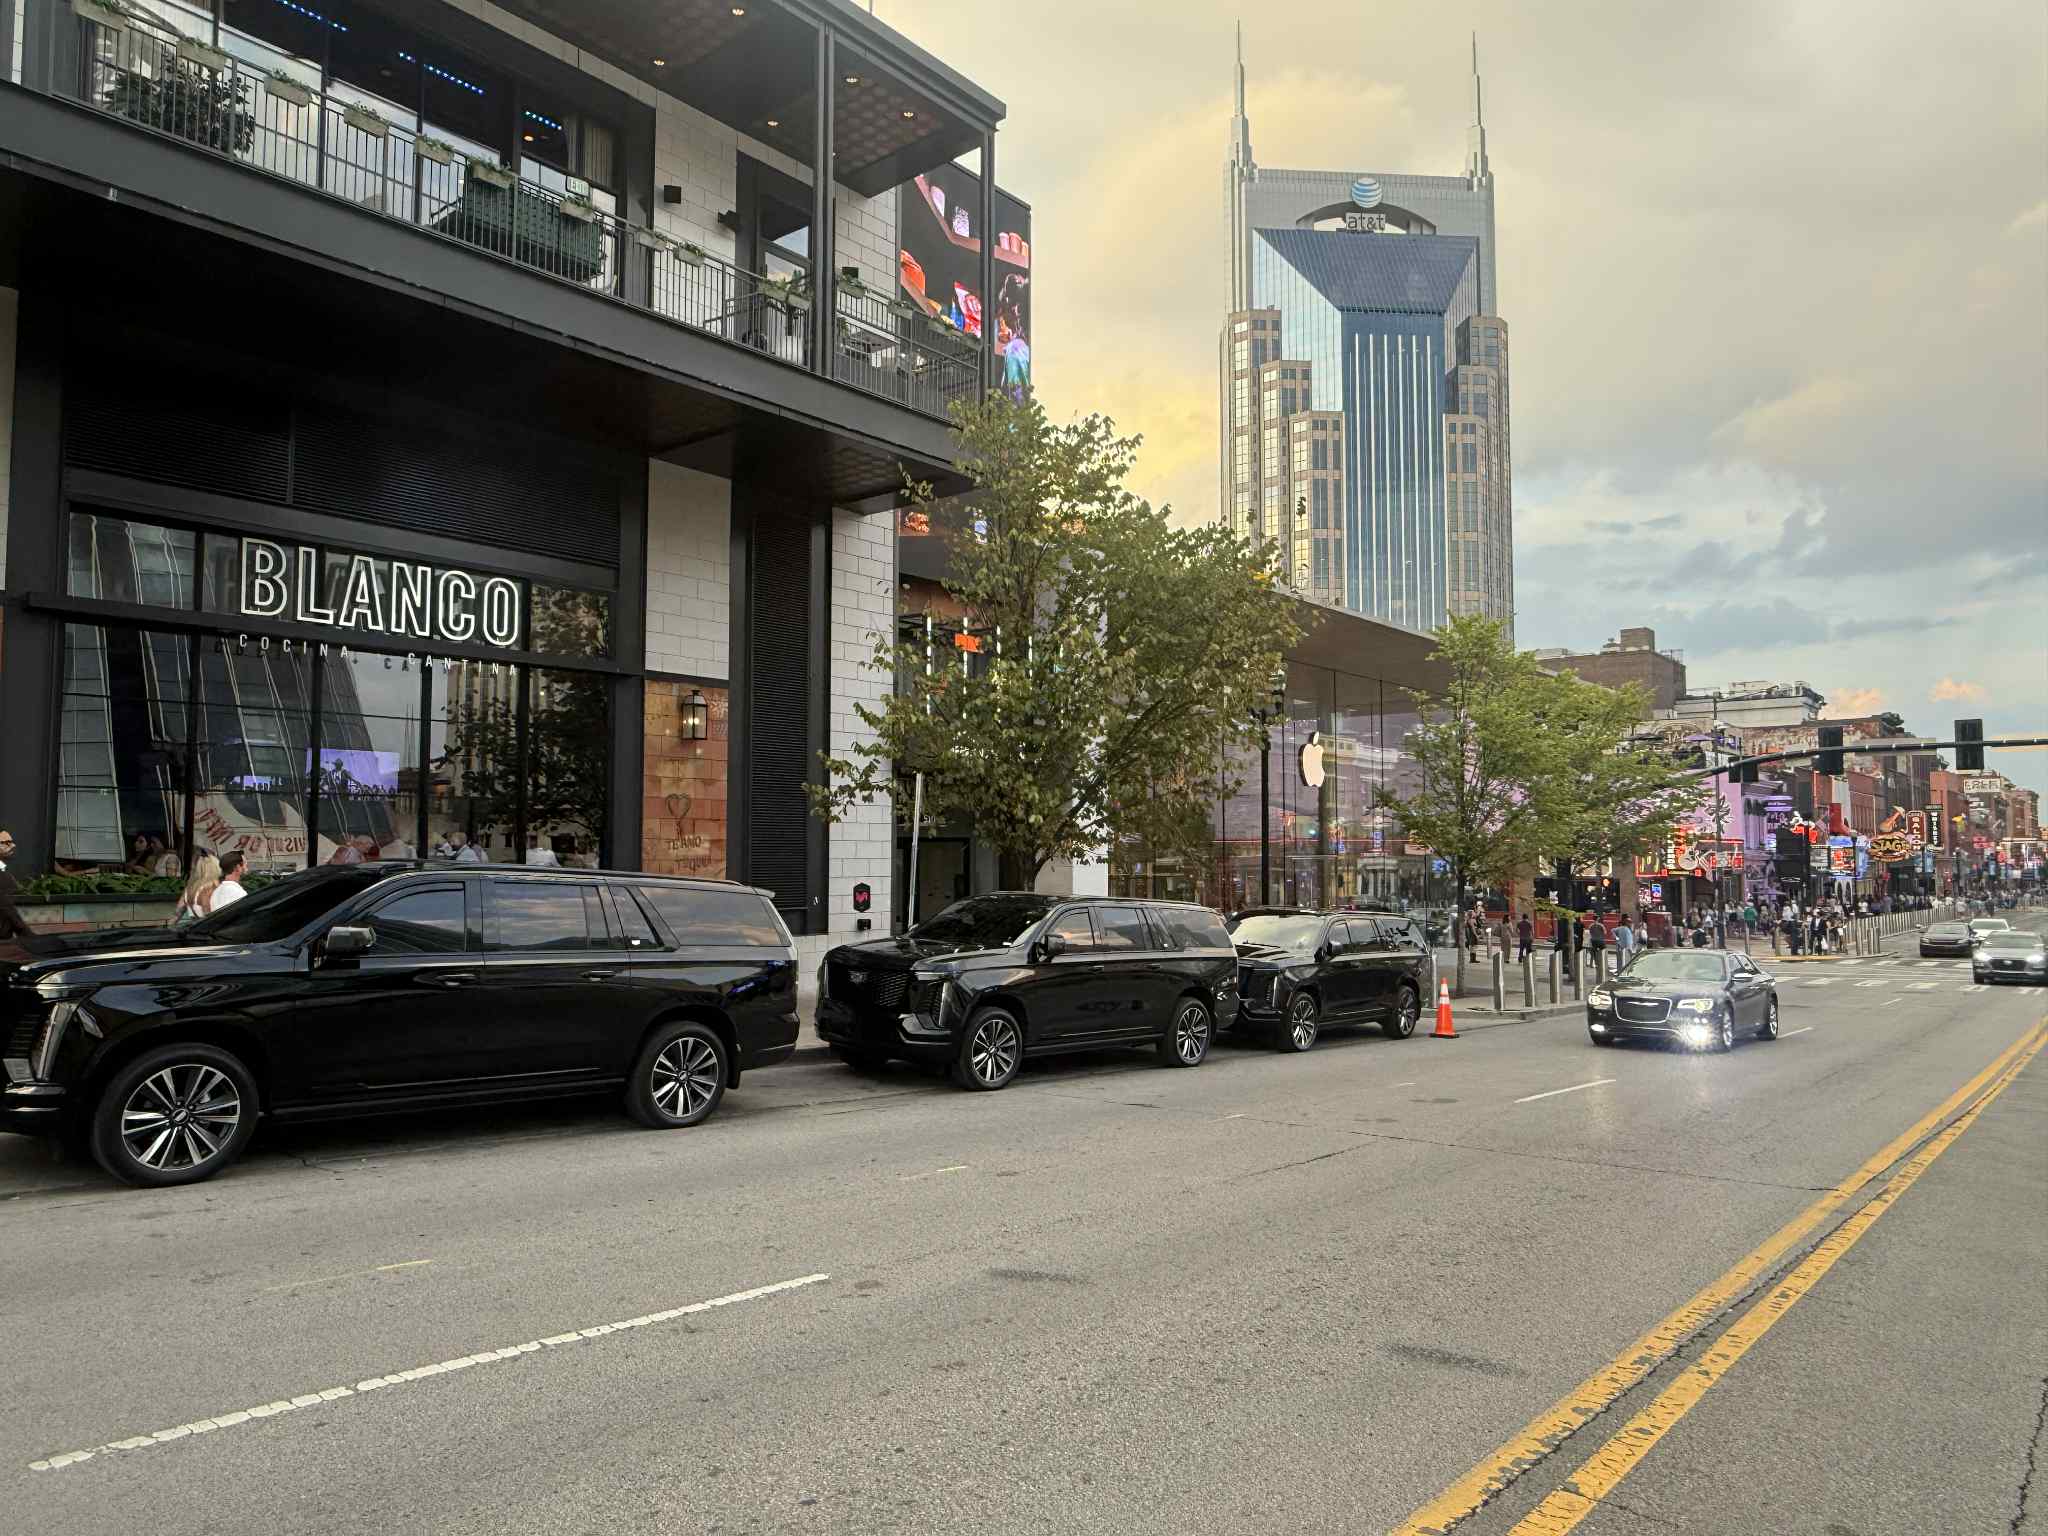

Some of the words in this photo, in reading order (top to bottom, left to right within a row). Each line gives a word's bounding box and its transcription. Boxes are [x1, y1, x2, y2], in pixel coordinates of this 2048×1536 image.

[1347, 213, 1386, 230] at&t
[240, 536, 521, 647] BLANCO
[239, 633, 349, 658] COCINA
[407, 652, 518, 676] CANTINA
